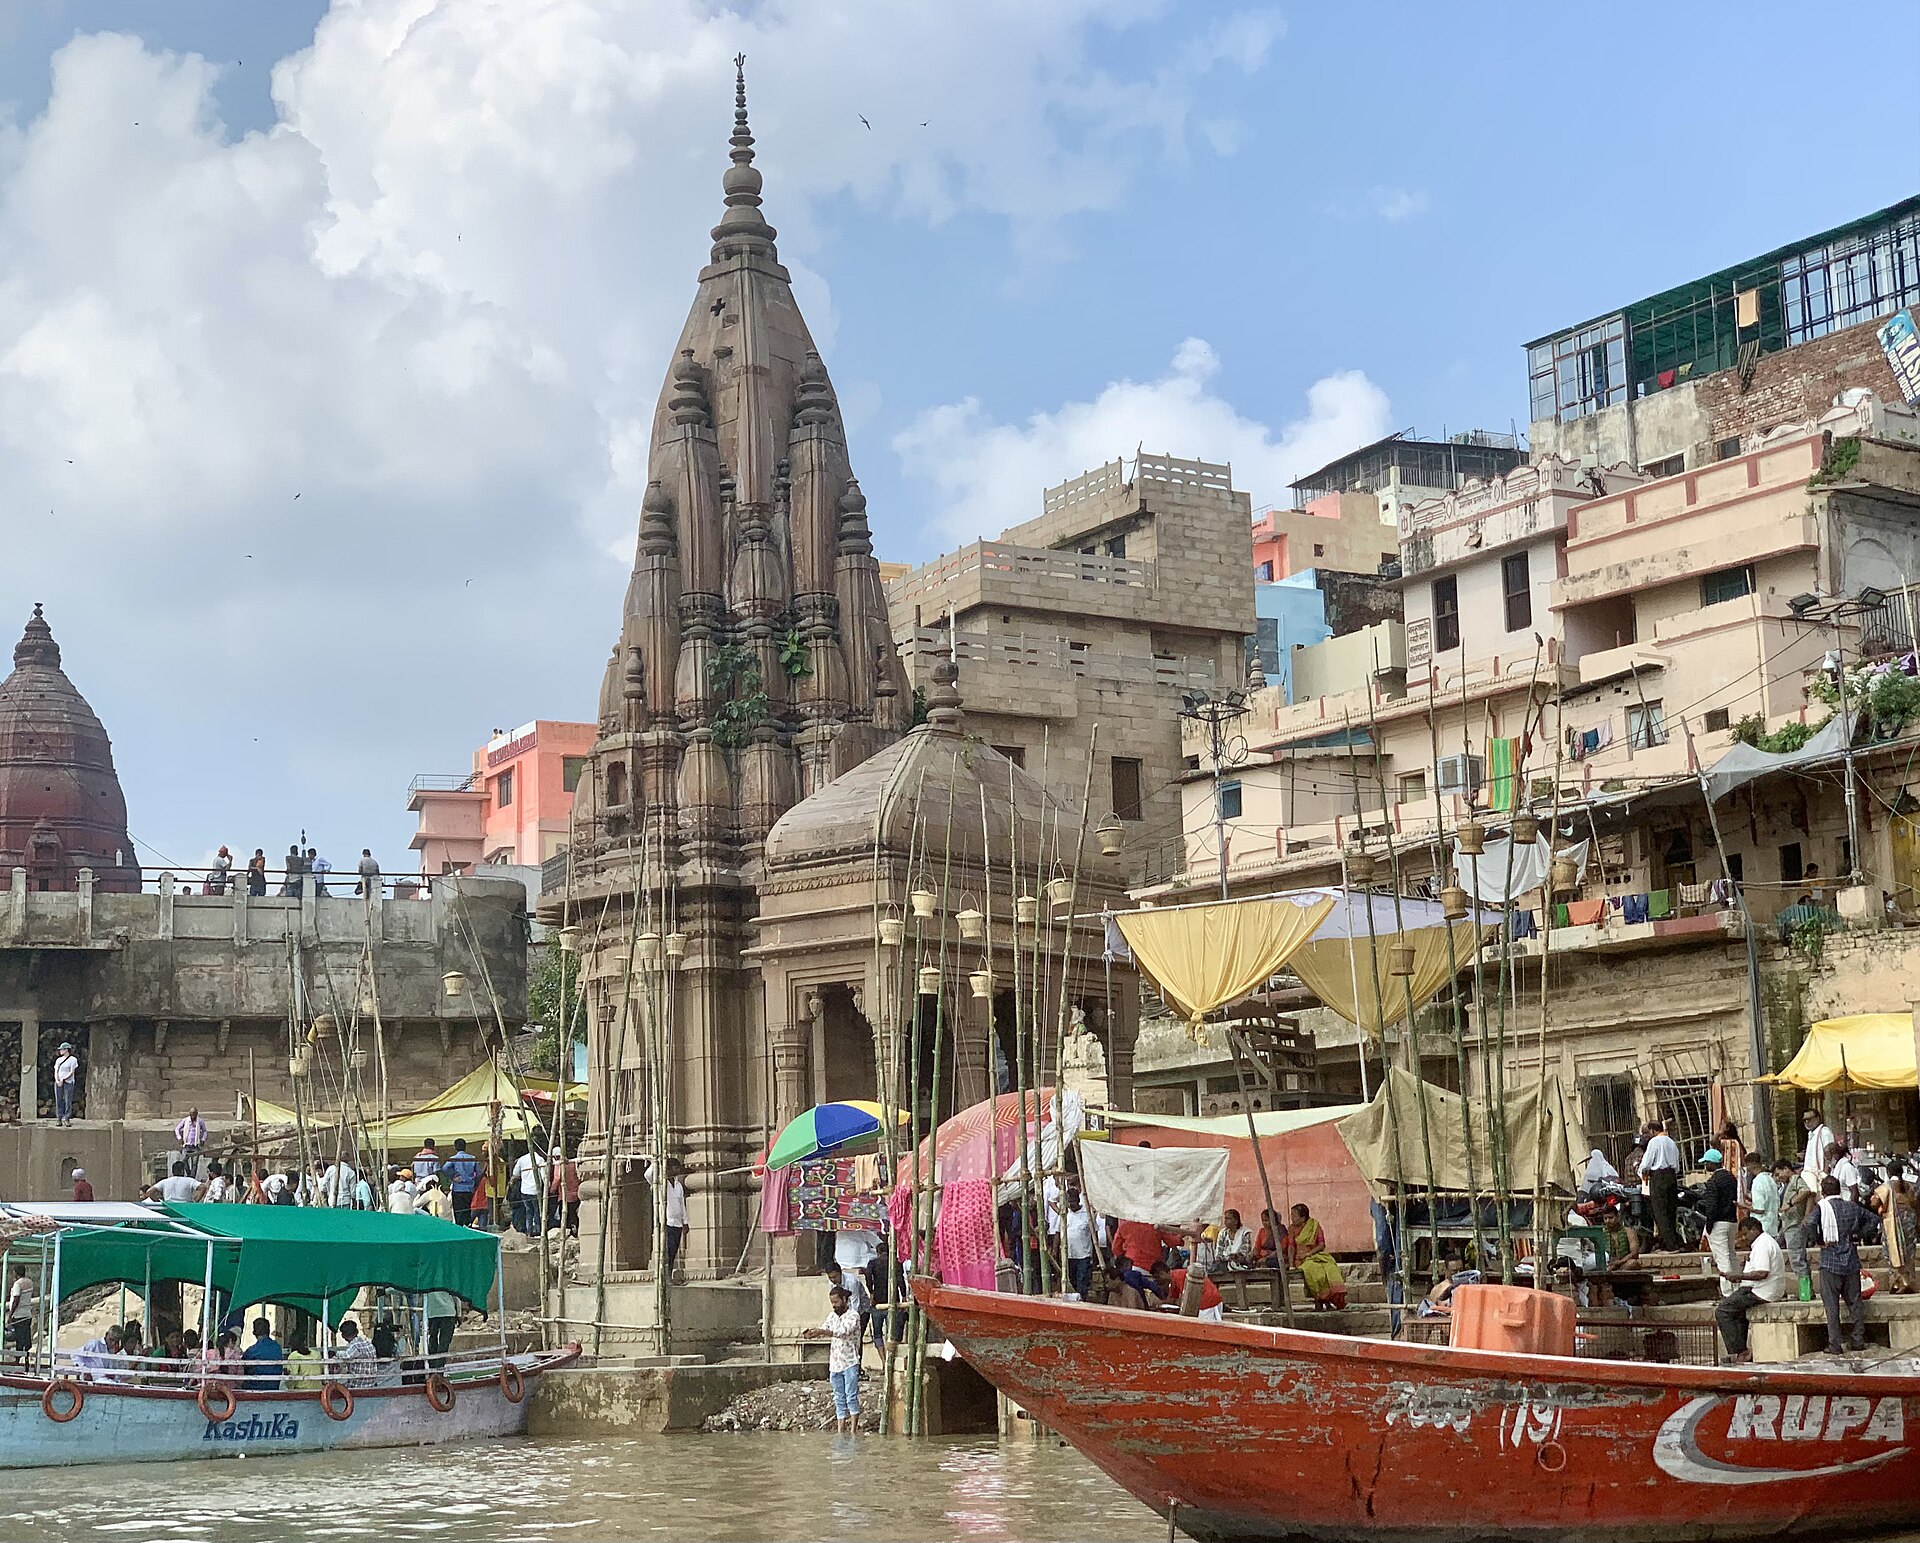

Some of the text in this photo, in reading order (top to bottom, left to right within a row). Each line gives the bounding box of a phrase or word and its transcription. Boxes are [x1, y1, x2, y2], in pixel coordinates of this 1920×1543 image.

[1887, 349, 1915, 403] GUEST HOUSE
[1896, 333, 1920, 398] KAS
[1727, 1394, 1905, 1442] RUPA
